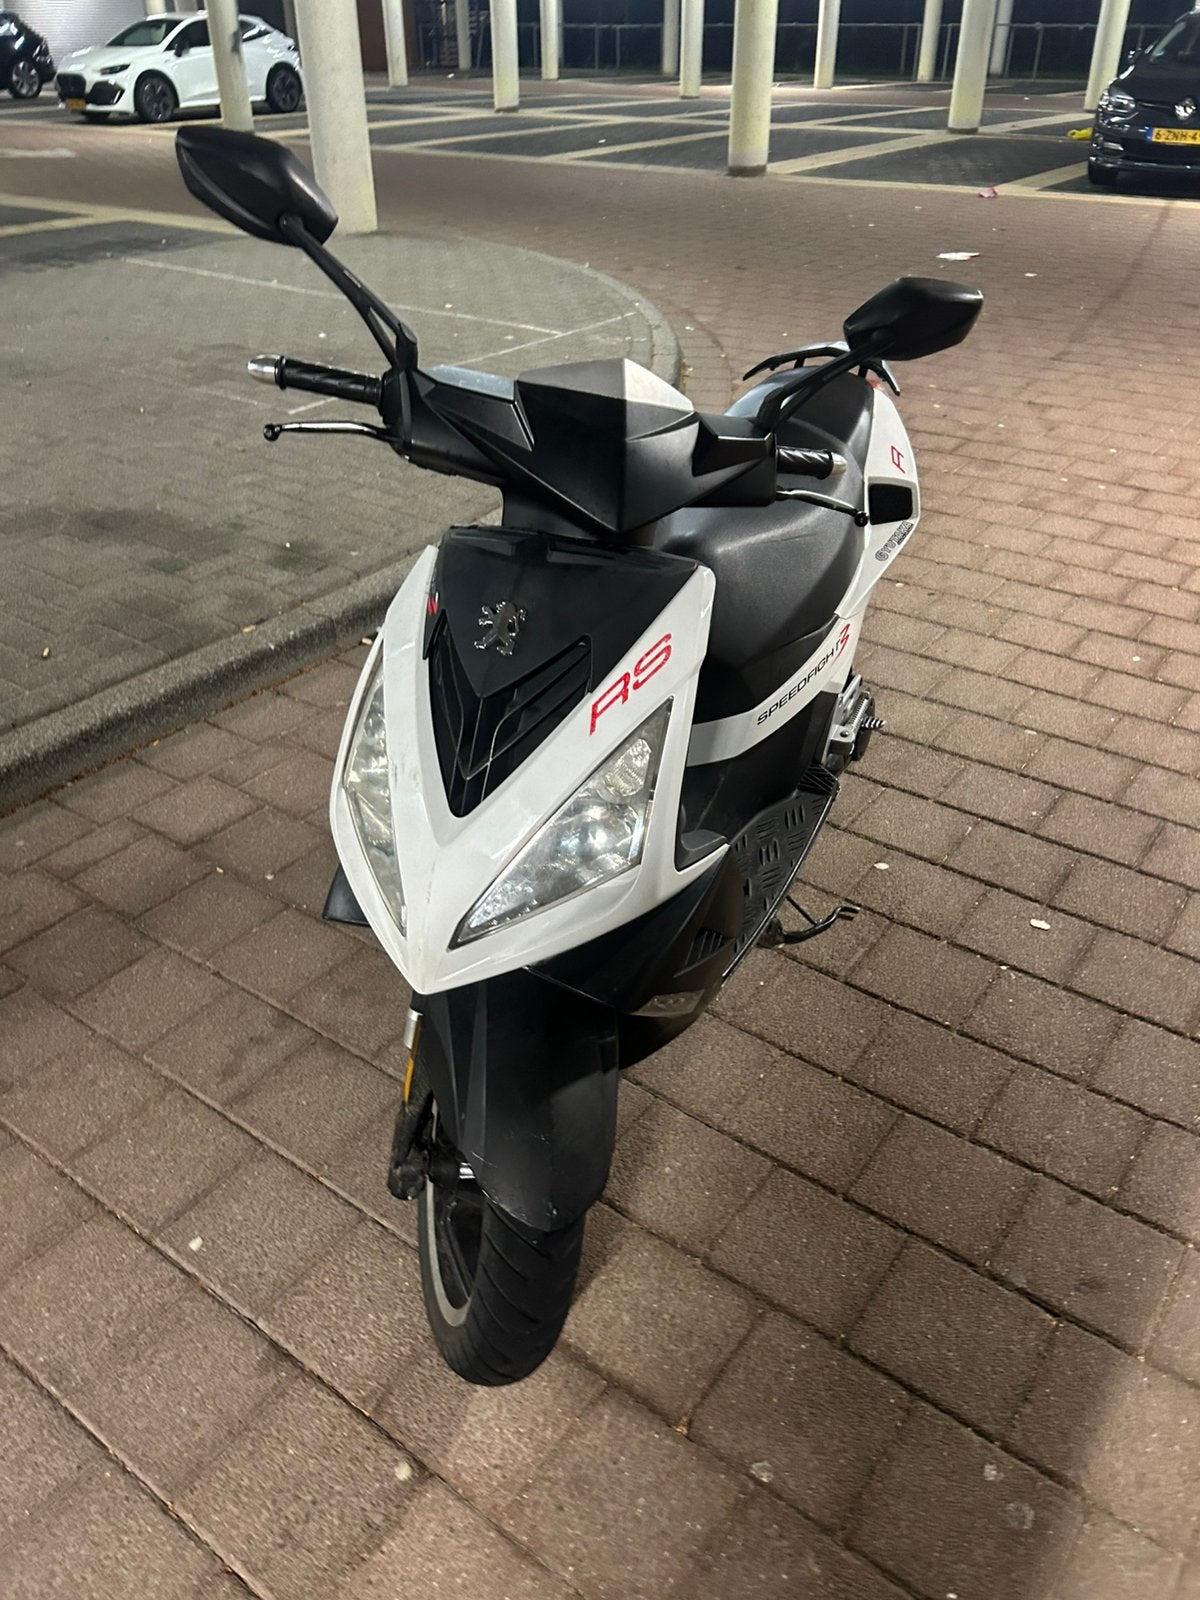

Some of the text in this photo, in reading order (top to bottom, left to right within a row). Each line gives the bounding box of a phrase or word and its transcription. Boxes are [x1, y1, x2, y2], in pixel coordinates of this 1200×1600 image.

[1155, 130, 1200, 142] 6-ZNH-4
[589, 632, 672, 736] RS
[757, 623, 850, 725] SPEEDFIGHT 3
